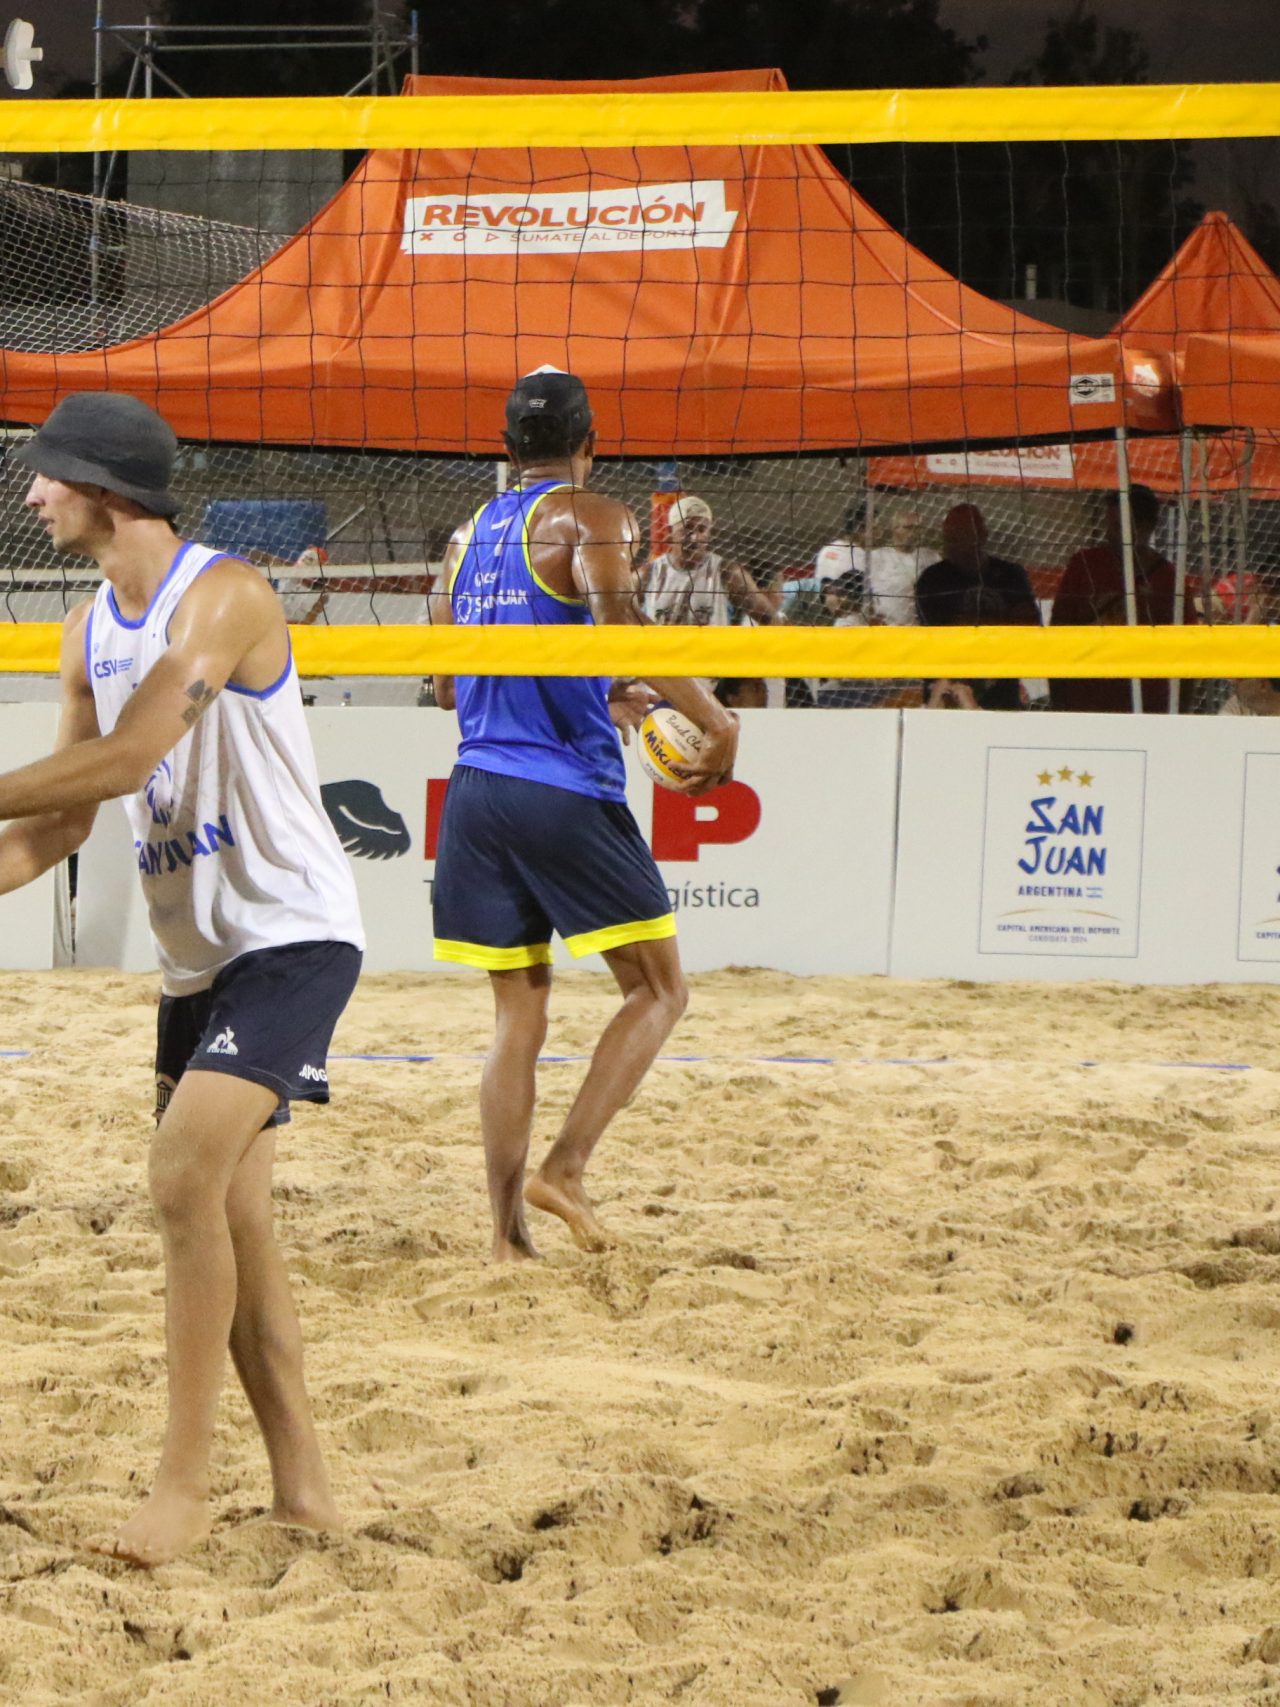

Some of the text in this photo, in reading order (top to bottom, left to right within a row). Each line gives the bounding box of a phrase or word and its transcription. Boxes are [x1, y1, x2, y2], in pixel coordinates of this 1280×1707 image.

[422, 195, 705, 228] REVOLUCIÓN
[510, 228, 700, 242] SUMATE AL DEPORTE
[94, 658, 117, 679] CSV
[1025, 796, 1105, 836] SAN
[135, 840, 162, 875] AN
[1017, 835, 1108, 876] JUAN
[1017, 885, 1084, 899] ARGENTINA
[997, 924, 1027, 933] CAPITAL
